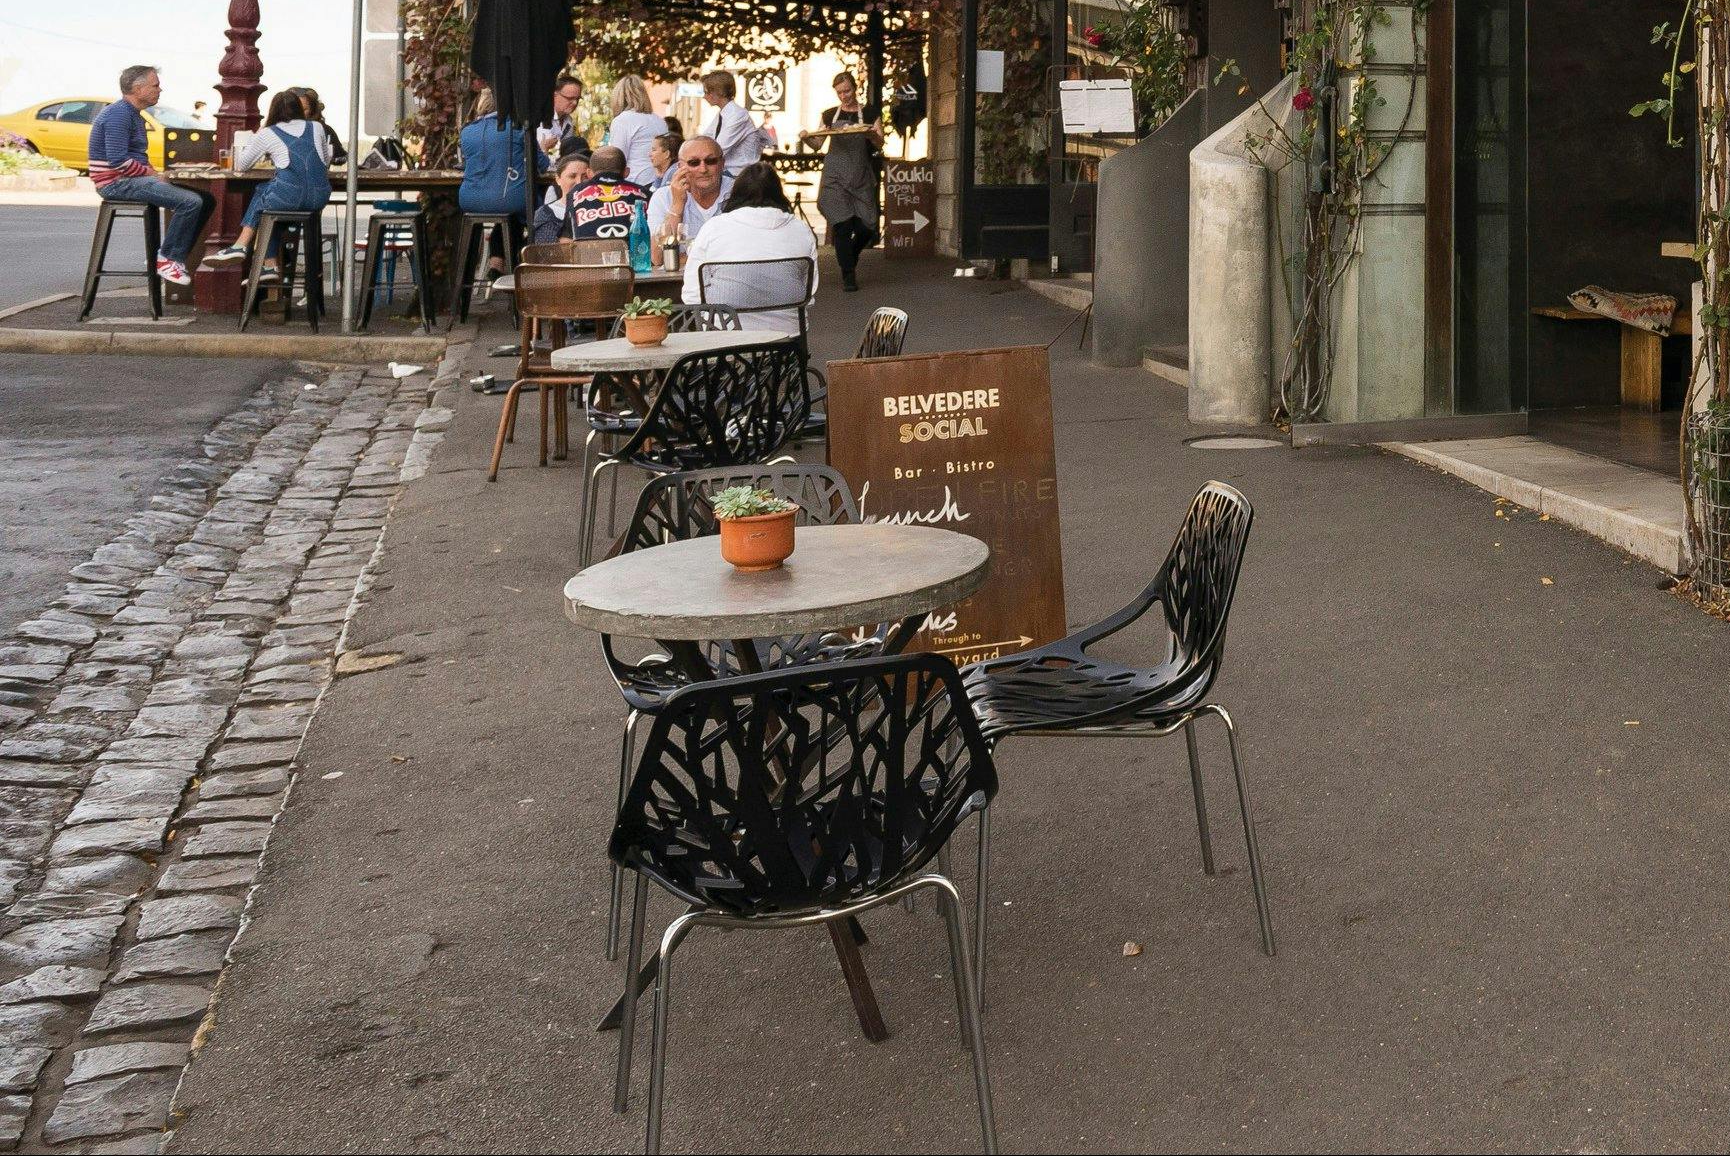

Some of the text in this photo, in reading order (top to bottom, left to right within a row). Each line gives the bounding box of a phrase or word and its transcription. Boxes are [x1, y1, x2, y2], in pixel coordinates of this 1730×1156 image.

[575, 202, 612, 226] Red
[883, 388, 1000, 417] BELVEDERE
[899, 417, 988, 444] SOCIAL
[894, 461, 995, 480] Bar Bistro
[933, 632, 982, 645] Through to
[949, 647, 1000, 666] tyard
